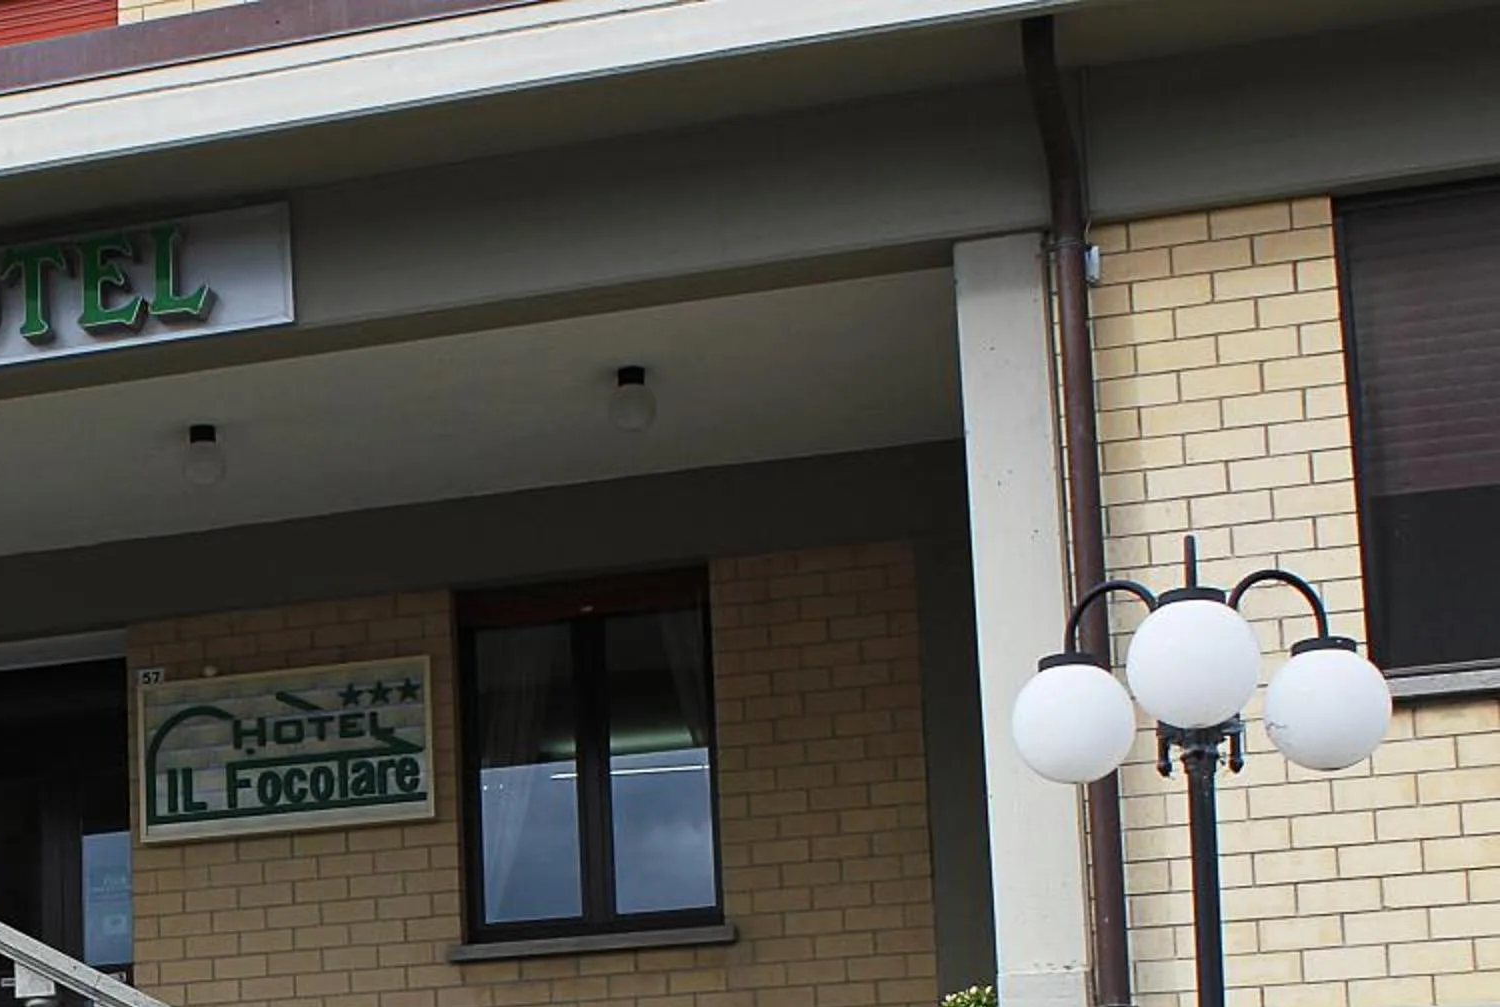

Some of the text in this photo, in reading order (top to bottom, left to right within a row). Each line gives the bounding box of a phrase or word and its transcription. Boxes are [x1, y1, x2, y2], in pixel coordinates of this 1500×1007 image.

[142, 671, 160, 685] 57
[232, 711, 395, 749] HOTEL
[167, 756, 420, 813] IL Focolare
